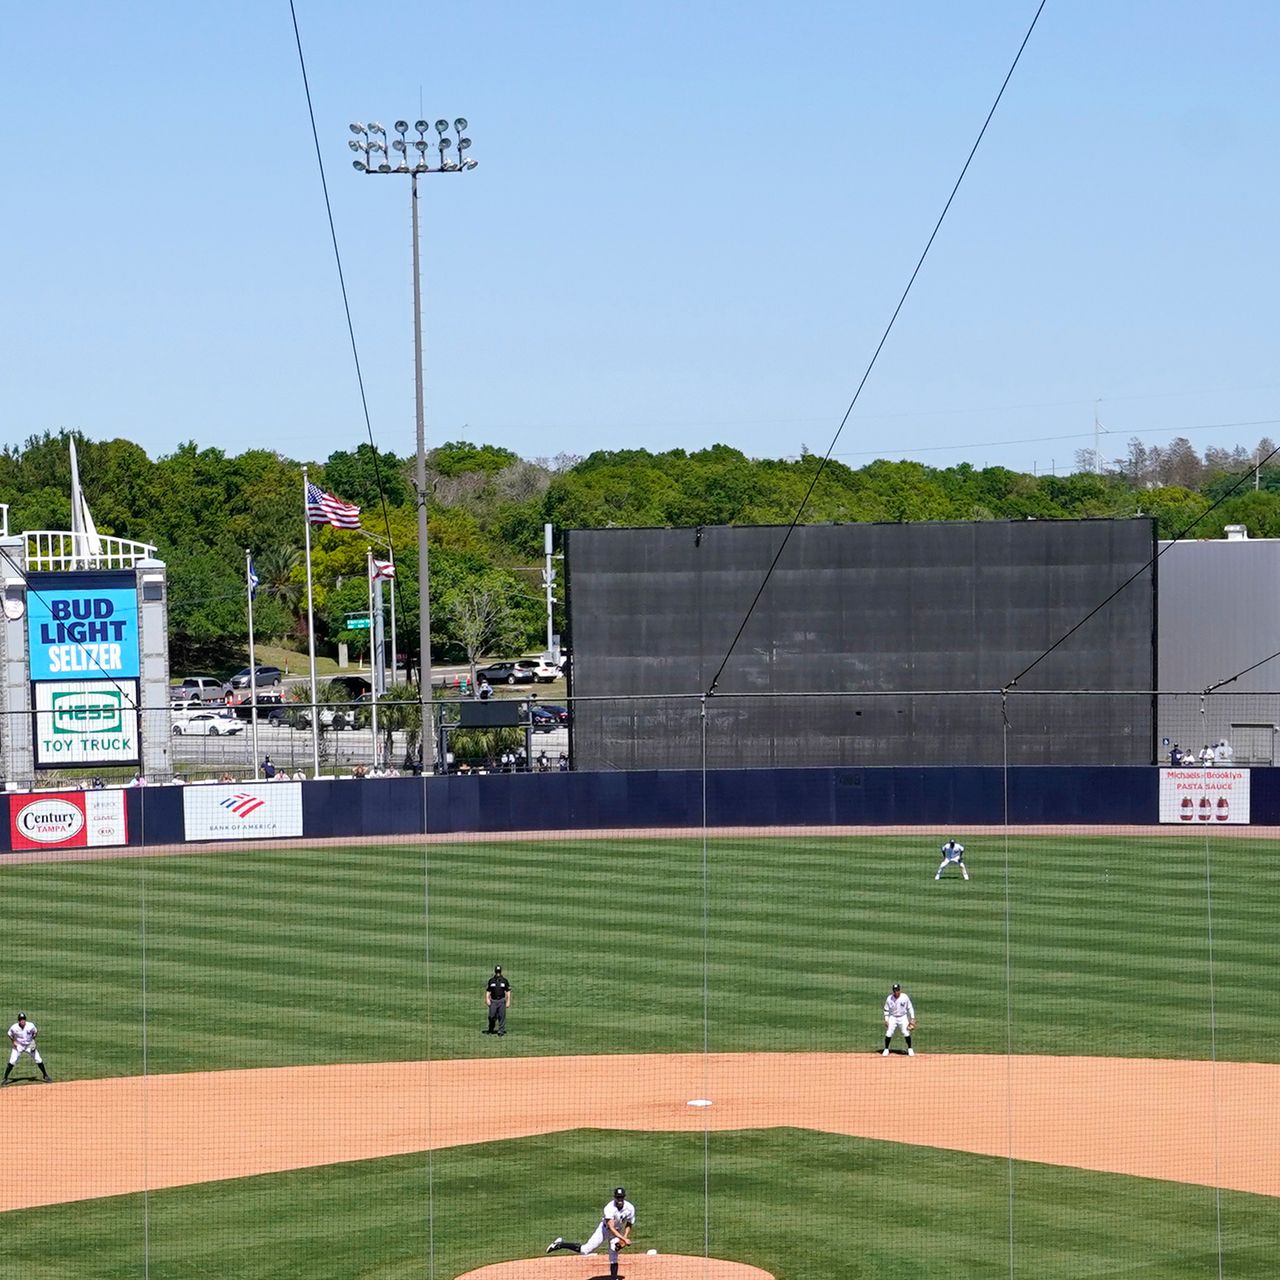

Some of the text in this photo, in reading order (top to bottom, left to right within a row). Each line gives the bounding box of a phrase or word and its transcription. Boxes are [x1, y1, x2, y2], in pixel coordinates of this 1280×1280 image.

[52, 599, 114, 621] BUD
[41, 620, 127, 645] LIGHT
[48, 643, 122, 672] SELTZER
[59, 704, 116, 721] HESS
[43, 739, 131, 752] TOY TRUCK
[1205, 783, 1232, 791] SAUCE
[24, 811, 76, 831] Century
[37, 825, 67, 833] TAMPA
